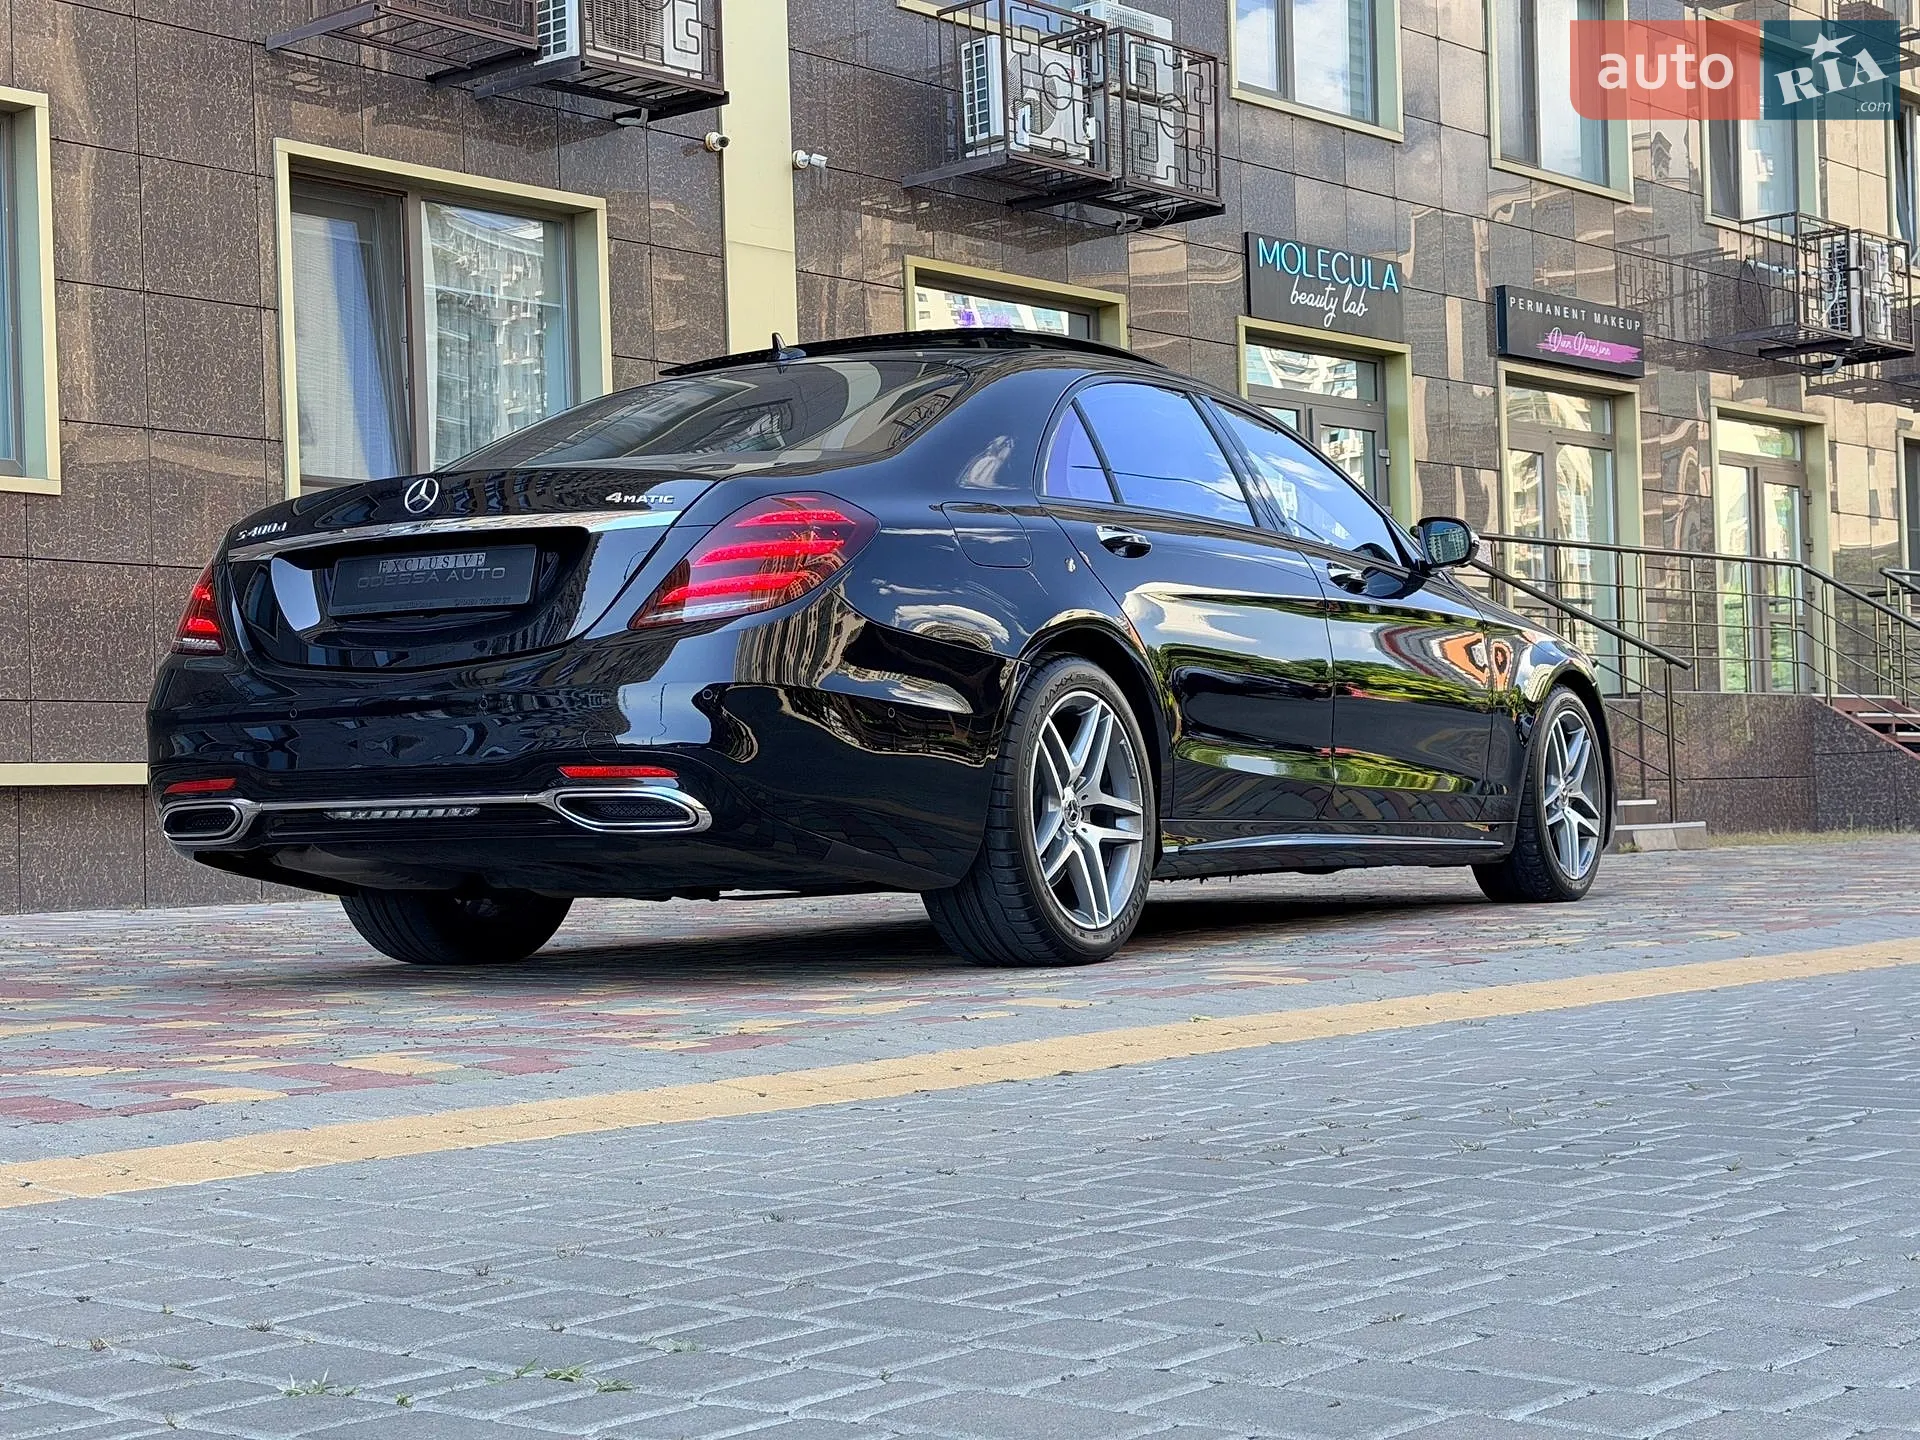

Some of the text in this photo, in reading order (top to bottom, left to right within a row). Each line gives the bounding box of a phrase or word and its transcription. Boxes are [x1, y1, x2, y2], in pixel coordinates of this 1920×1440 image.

[1257, 237, 1399, 294] MOLECULA
[1290, 275, 1368, 327] beauty lab
[1509, 296, 1641, 331] PERMANENT MAKEUP
[606, 492, 674, 503] 4MATIC
[378, 552, 486, 574] EXCLUSIVE
[357, 567, 506, 588] ODESSA AUTO
